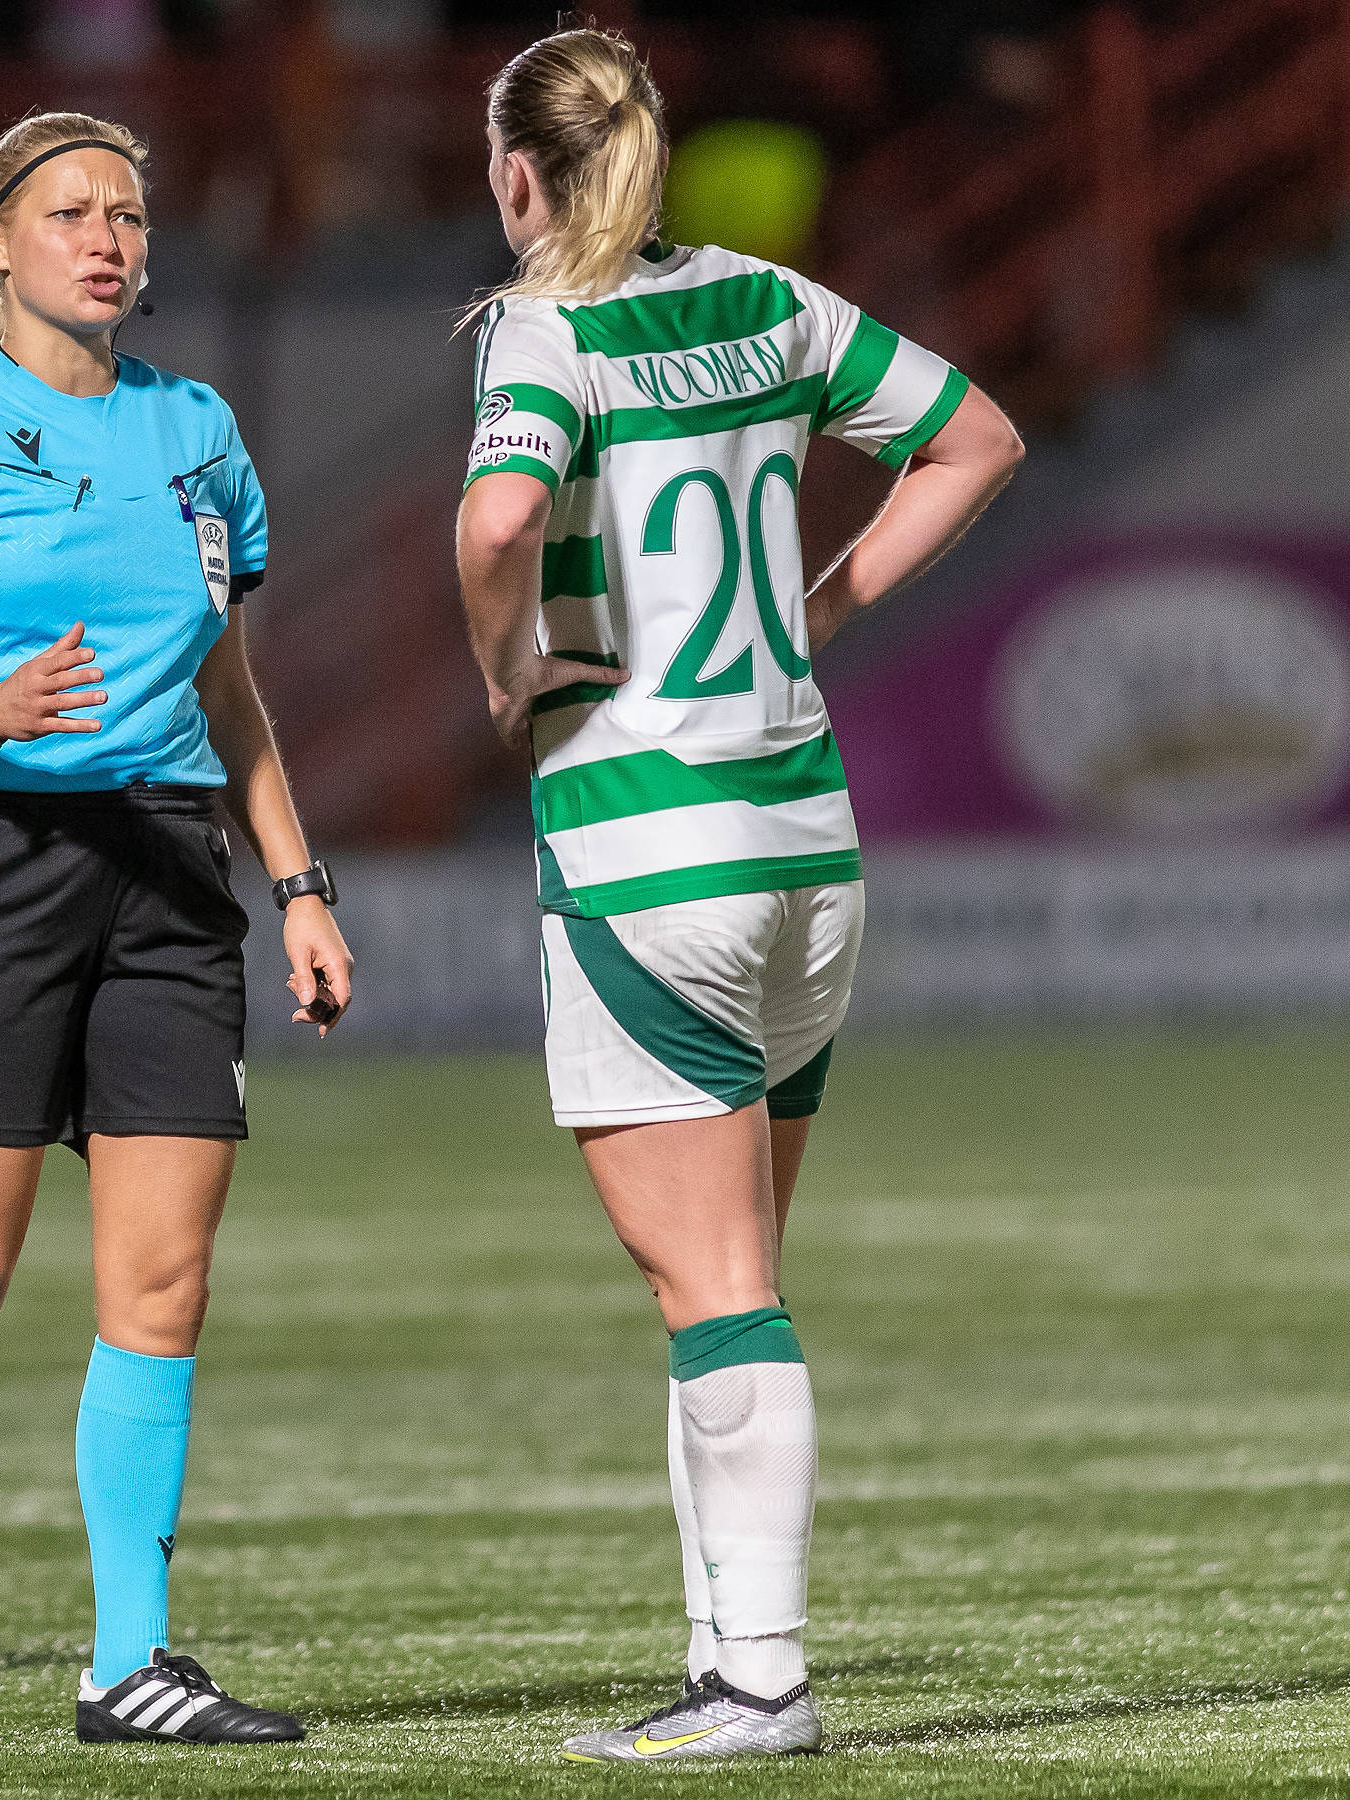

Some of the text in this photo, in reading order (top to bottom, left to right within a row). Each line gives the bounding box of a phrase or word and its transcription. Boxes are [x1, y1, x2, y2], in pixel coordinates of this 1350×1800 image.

[627, 334, 786, 406] NOONAN
[469, 432, 552, 459] ebuilt
[473, 451, 508, 464] up
[640, 450, 811, 701] 20
